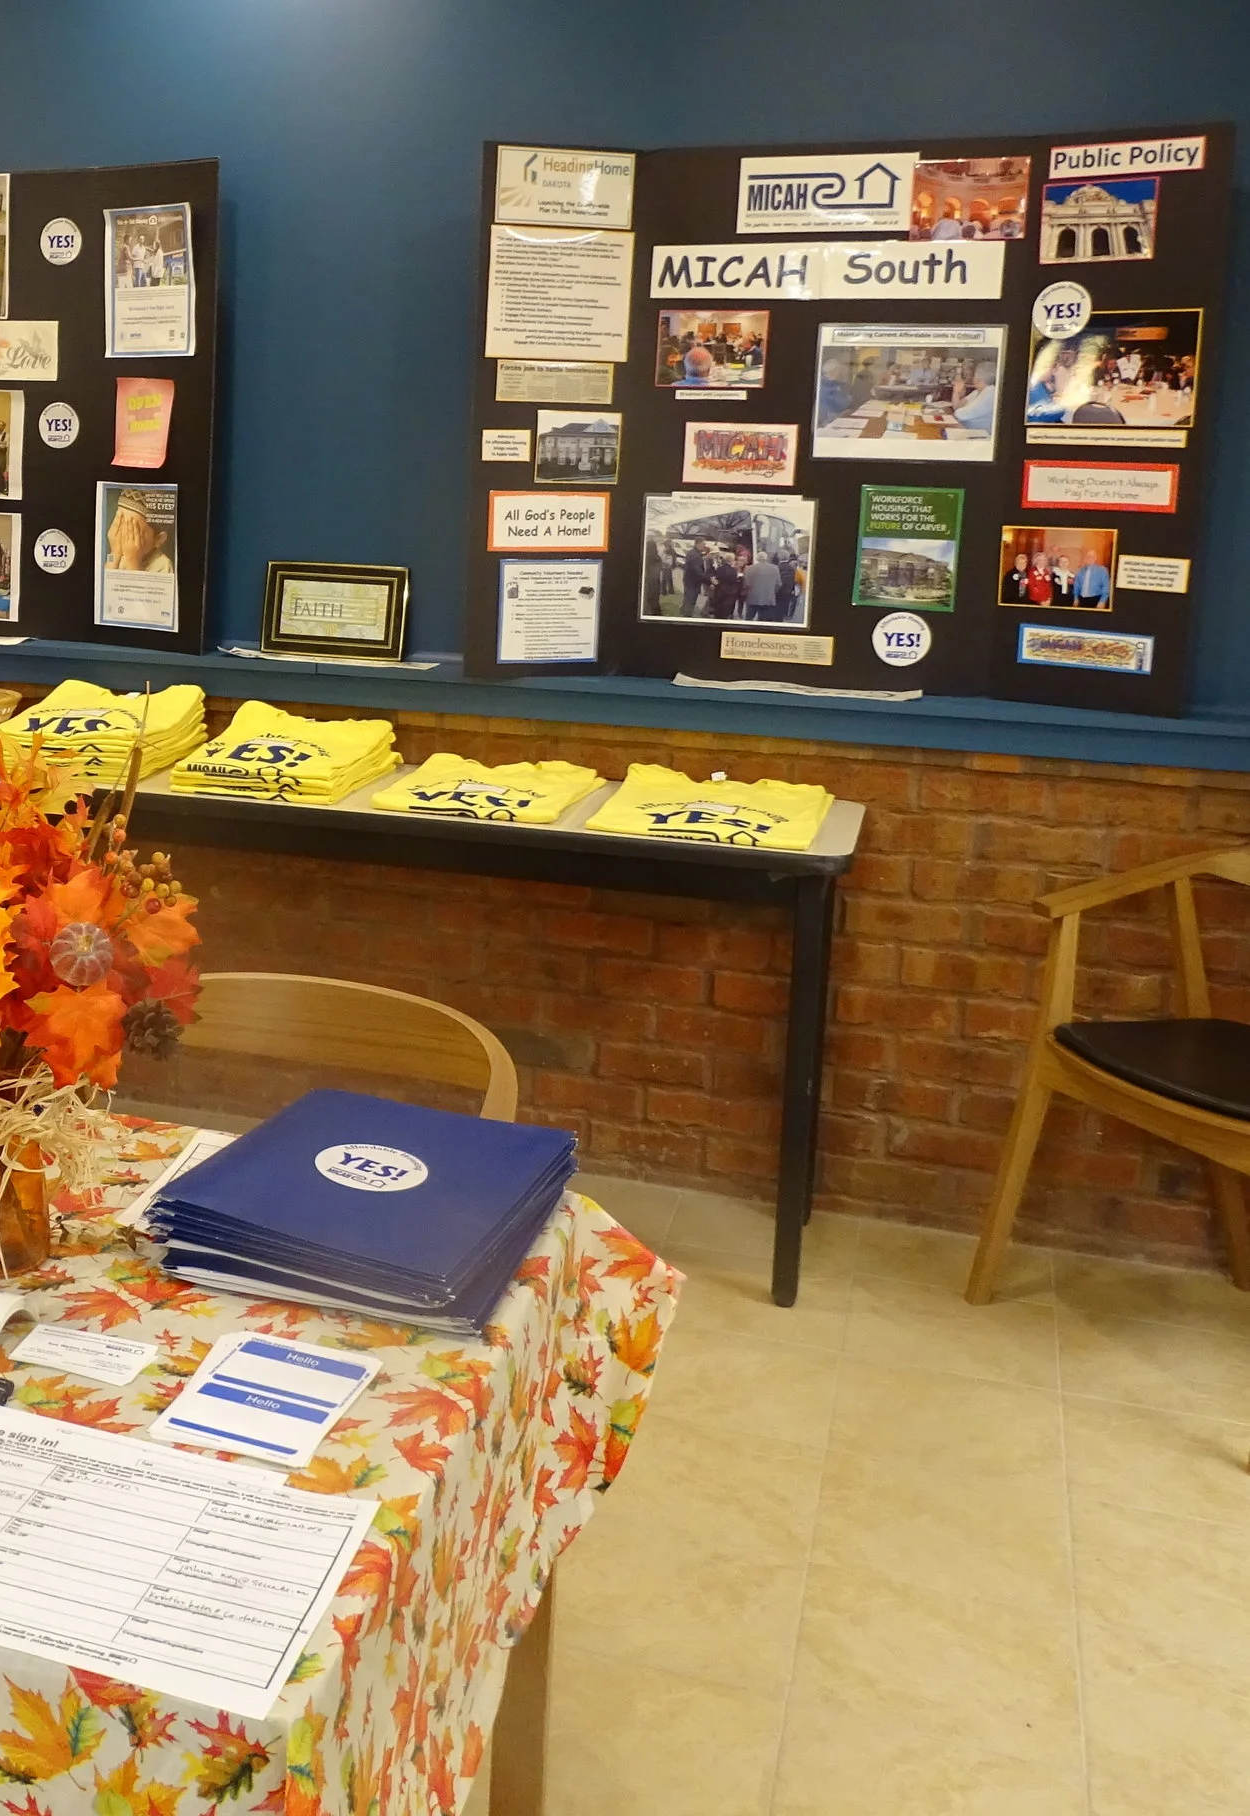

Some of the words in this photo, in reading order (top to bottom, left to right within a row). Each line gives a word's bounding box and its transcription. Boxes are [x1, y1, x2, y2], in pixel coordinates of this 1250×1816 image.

[1054, 149, 1121, 170] Public
[1129, 143, 1199, 166] Policy
[747, 184, 808, 211] MICAH
[48, 235, 74, 248] YES!
[658, 255, 807, 288] MICAH
[844, 249, 967, 285] South
[1043, 303, 1081, 319] YES!
[6, 345, 51, 369] Love
[523, 365, 535, 373] join
[46, 419, 71, 431] YES!
[696, 430, 784, 461] MICAH
[1047, 475, 1085, 487] Working
[871, 495, 923, 504] WORKFORCE
[1064, 488, 1081, 499] Pay
[1084, 488, 1100, 498] For
[1103, 490, 1111, 498] A
[1112, 490, 1139, 500] Home
[504, 509, 519, 521] All
[524, 509, 555, 521] God's
[559, 508, 595, 522] People
[871, 504, 910, 512] HOUSING
[911, 505, 933, 513] THAT
[870, 513, 900, 521] WORKS
[901, 514, 918, 522] FOR
[919, 514, 936, 522] THE
[507, 525, 538, 537] Need
[543, 525, 552, 536] A
[557, 524, 591, 537] Home!
[869, 521, 901, 530] FUTURE
[914, 523, 947, 531] CARVER
[42, 545, 67, 557] YES!
[293, 597, 343, 618] FAITH
[725, 637, 798, 650] Homelessness
[884, 632, 921, 648] YES!
[205, 743, 313, 768] YES!
[338, 1152, 409, 1181] YES!
[286, 1352, 319, 1366] Hello
[245, 1395, 281, 1409] Hello
[7, 1427, 39, 1447] sign
[40, 1434, 59, 1450] in!
